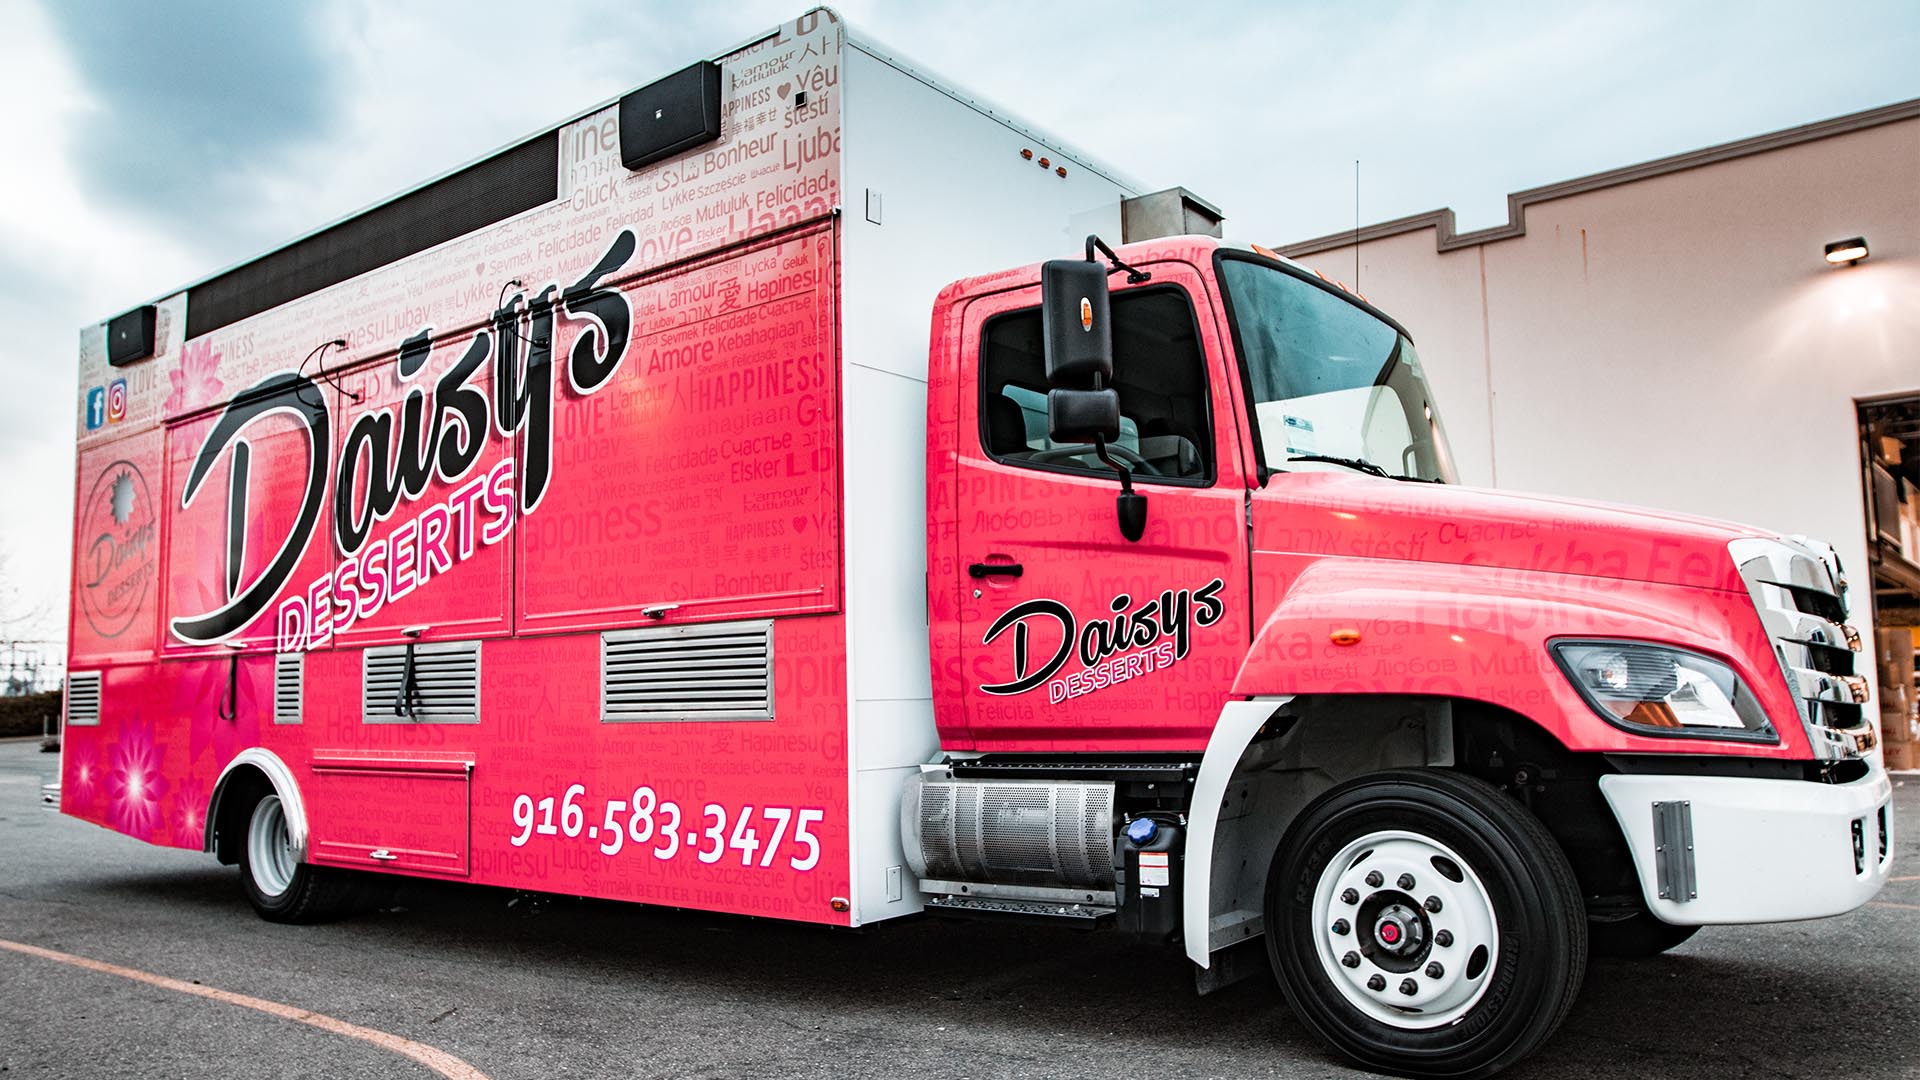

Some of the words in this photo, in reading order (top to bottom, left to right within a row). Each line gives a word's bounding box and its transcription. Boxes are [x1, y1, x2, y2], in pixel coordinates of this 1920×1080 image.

[731, 50, 796, 84] L'amour
[704, 131, 778, 175] Bonheur
[573, 176, 619, 212] Glück
[662, 187, 695, 212] Lykke
[696, 191, 750, 225] Mutluluk
[606, 202, 654, 233] Felicidad
[538, 225, 601, 260] Felicidade
[489, 249, 533, 276] Sevmek
[456, 279, 494, 309] Lykke
[658, 279, 718, 313] L'amour
[749, 268, 822, 303] Hapinesu
[387, 302, 432, 336] Ljubav
[703, 311, 757, 337] Felicidade
[759, 296, 812, 321] Счастье
[661, 327, 699, 347] Sevmek
[717, 319, 804, 354] Kebahagiaan
[647, 339, 714, 377] Amore
[610, 383, 667, 411] L'amour
[699, 351, 825, 412] HAPPINESS
[554, 396, 605, 442] LOVE
[173, 230, 638, 645] Daisys
[561, 435, 621, 471] Ljubav
[721, 432, 793, 460] Счастье
[646, 444, 718, 475] Felicidade
[731, 458, 781, 484] Elsker
[726, 518, 785, 543] HAPPINESS
[971, 507, 1064, 535] Любовь
[1438, 520, 1540, 545] Счастье
[277, 457, 517, 654] DESSERTS
[576, 569, 625, 600] Glück
[715, 570, 793, 598] Bonheur
[977, 699, 1034, 722] Felicità
[511, 784, 823, 871] 916.583.3475
[636, 883, 690, 901] BETTER
[694, 889, 735, 908] THAN
[740, 893, 794, 913] BACON
